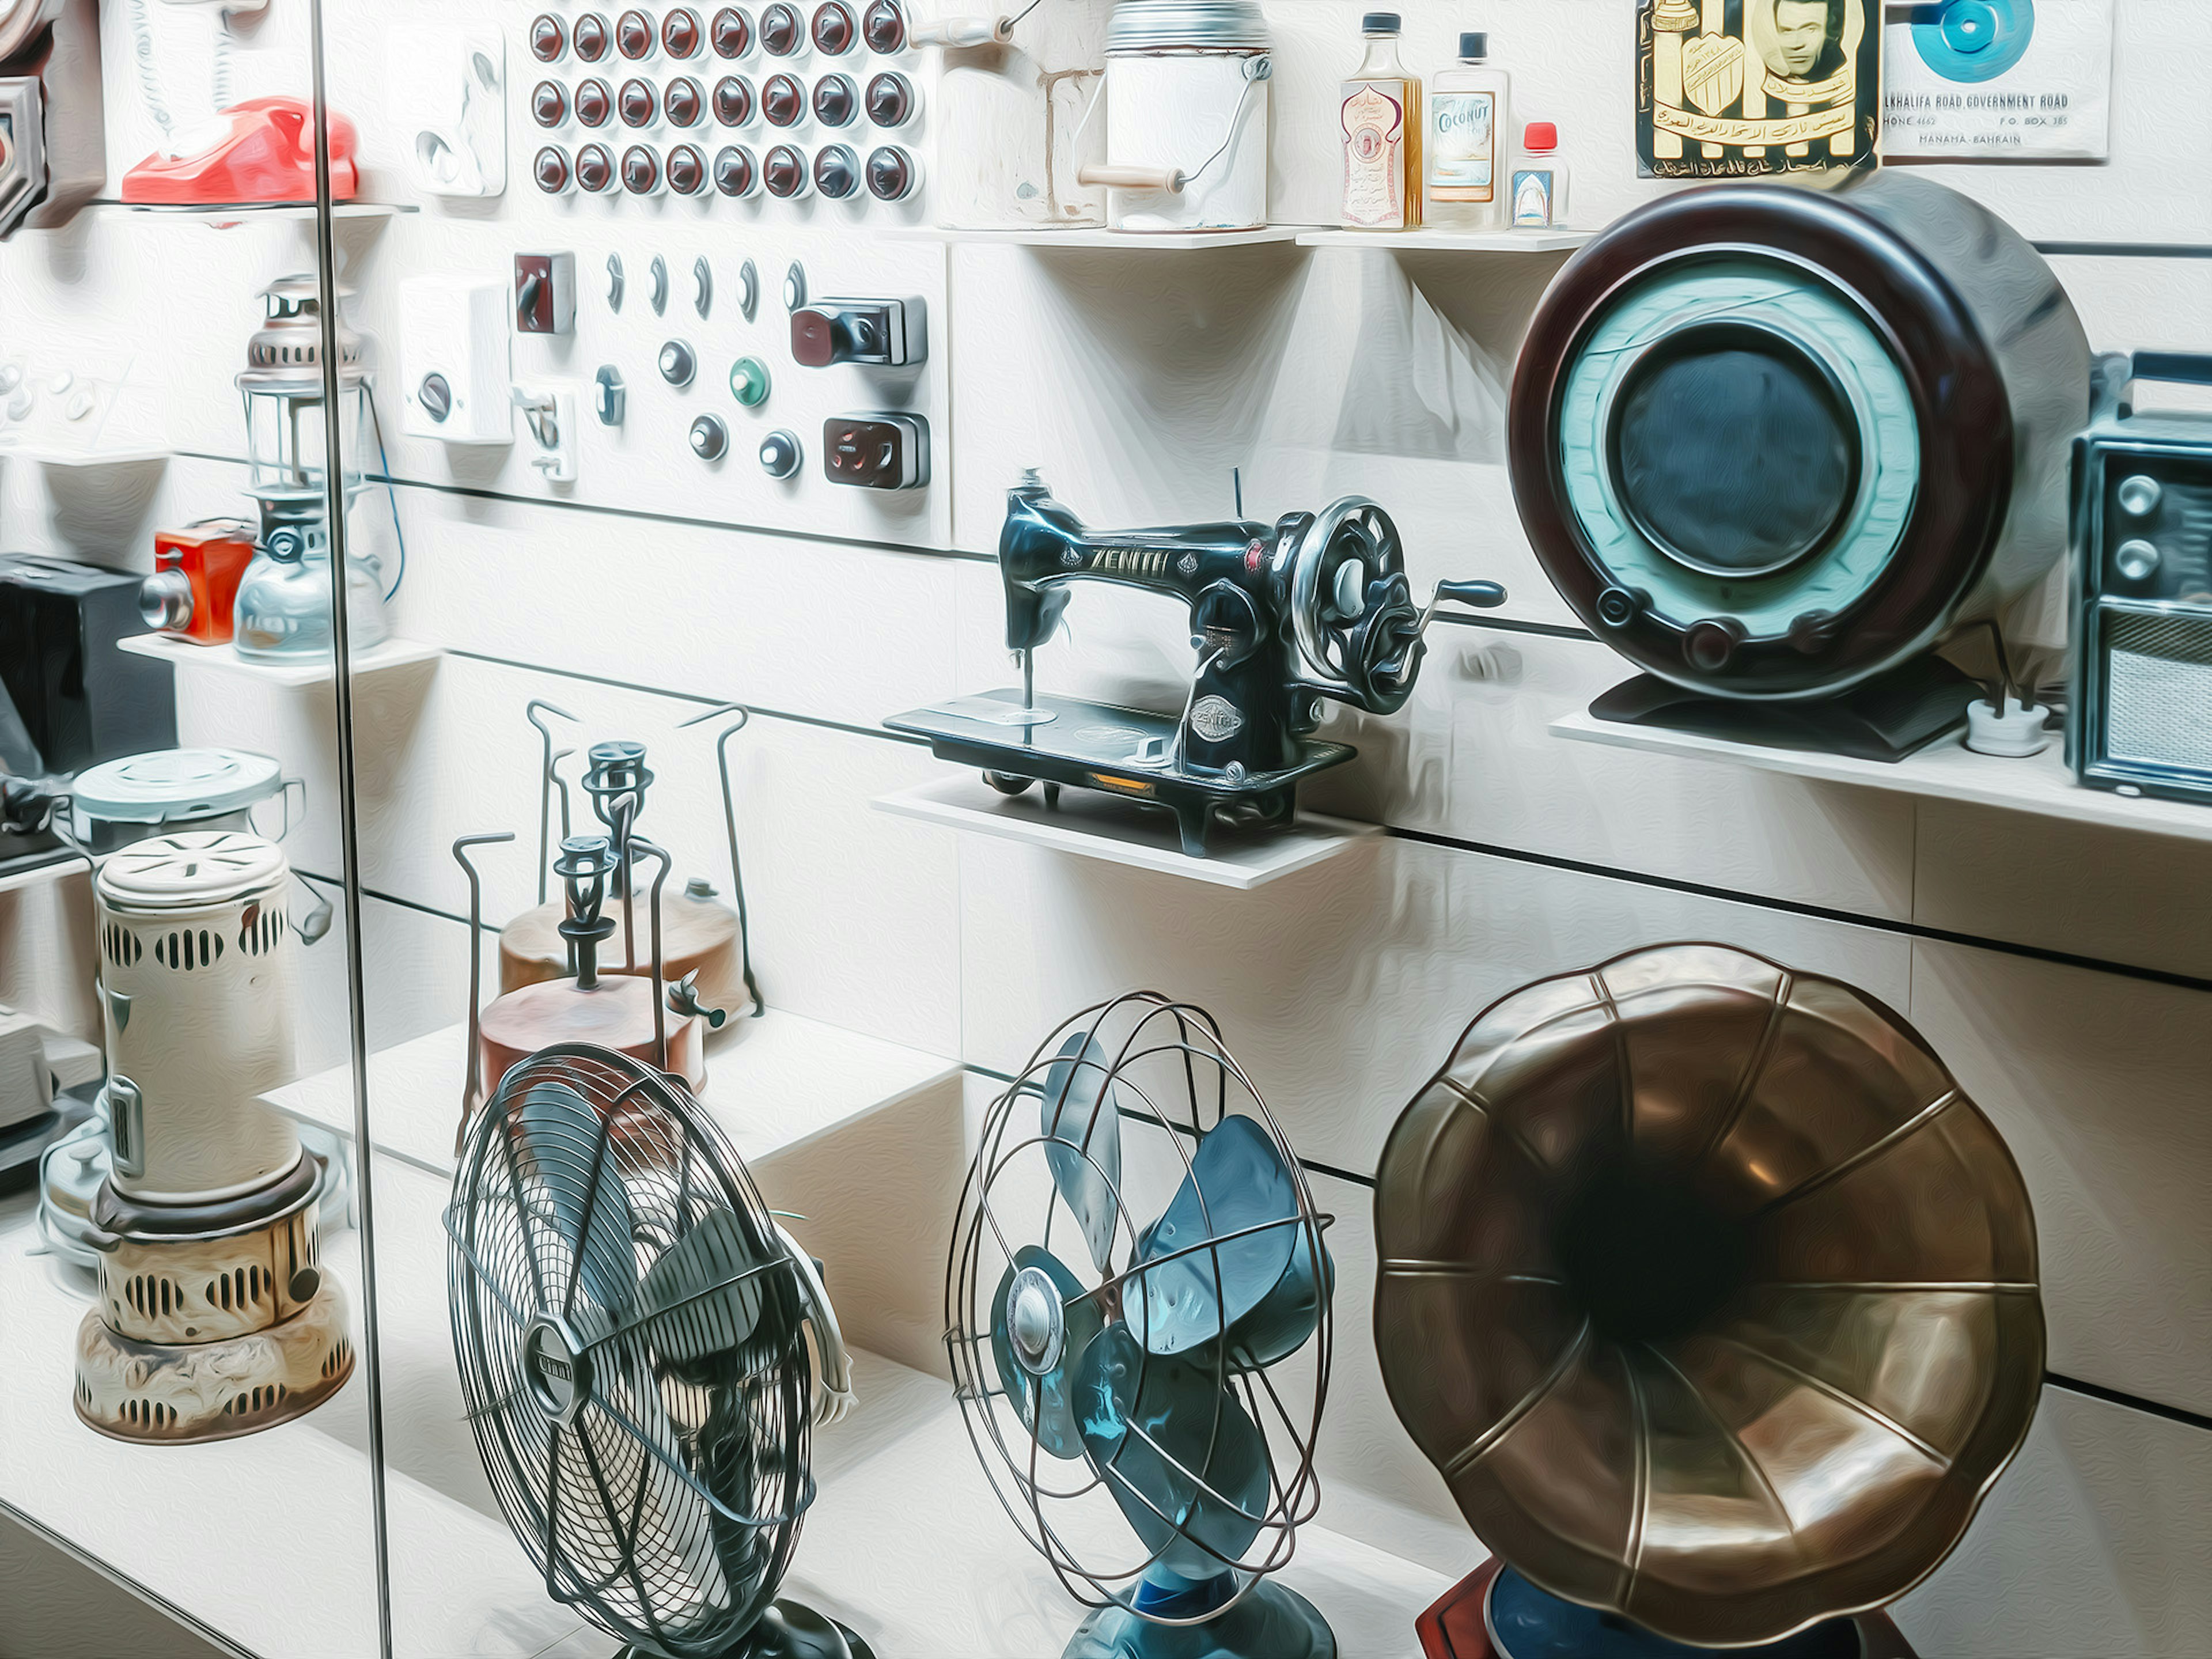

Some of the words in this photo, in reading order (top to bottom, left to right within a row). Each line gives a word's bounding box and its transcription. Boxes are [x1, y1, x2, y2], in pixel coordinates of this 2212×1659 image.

[1885, 94, 1931, 108] LKHALIFA
[1967, 94, 2035, 108] GOVERNMENT
[2040, 94, 2069, 108] ROAD
[1439, 105, 1488, 133] COCONUT
[1883, 117, 1912, 125] HONE
[2025, 117, 2046, 126] BOX
[1090, 548, 1171, 572] ZENITH
